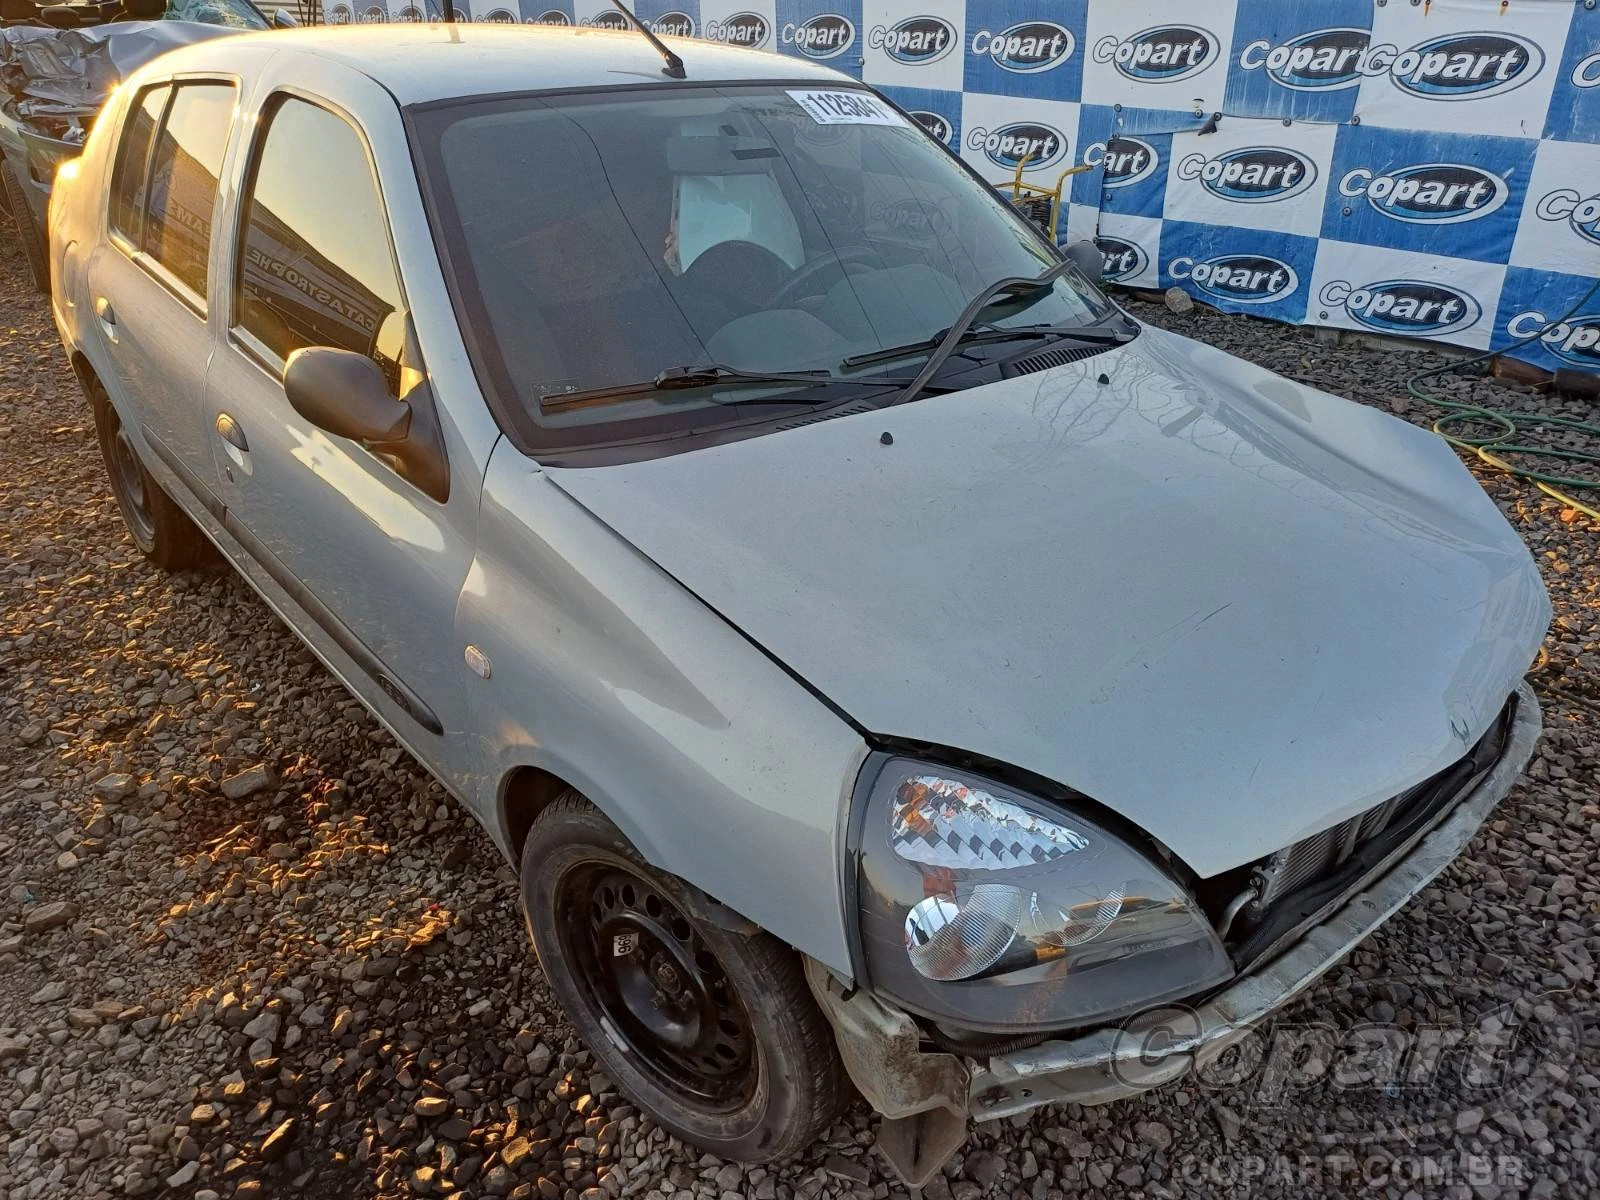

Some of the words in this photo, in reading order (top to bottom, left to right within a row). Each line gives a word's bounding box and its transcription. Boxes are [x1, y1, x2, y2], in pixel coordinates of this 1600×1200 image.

[706, 20, 762, 43] Copart
[781, 23, 847, 49] Copart
[868, 25, 946, 53] Copart
[971, 30, 1063, 61] Copart
[1092, 35, 1204, 70] Copart
[1239, 39, 1370, 77] Copart
[1360, 43, 1521, 84] Copart
[966, 126, 1056, 159] Copart
[1177, 153, 1300, 188] Copart
[1338, 168, 1489, 209] Copart
[1168, 256, 1284, 292] Copart
[1319, 280, 1461, 324] Copart
